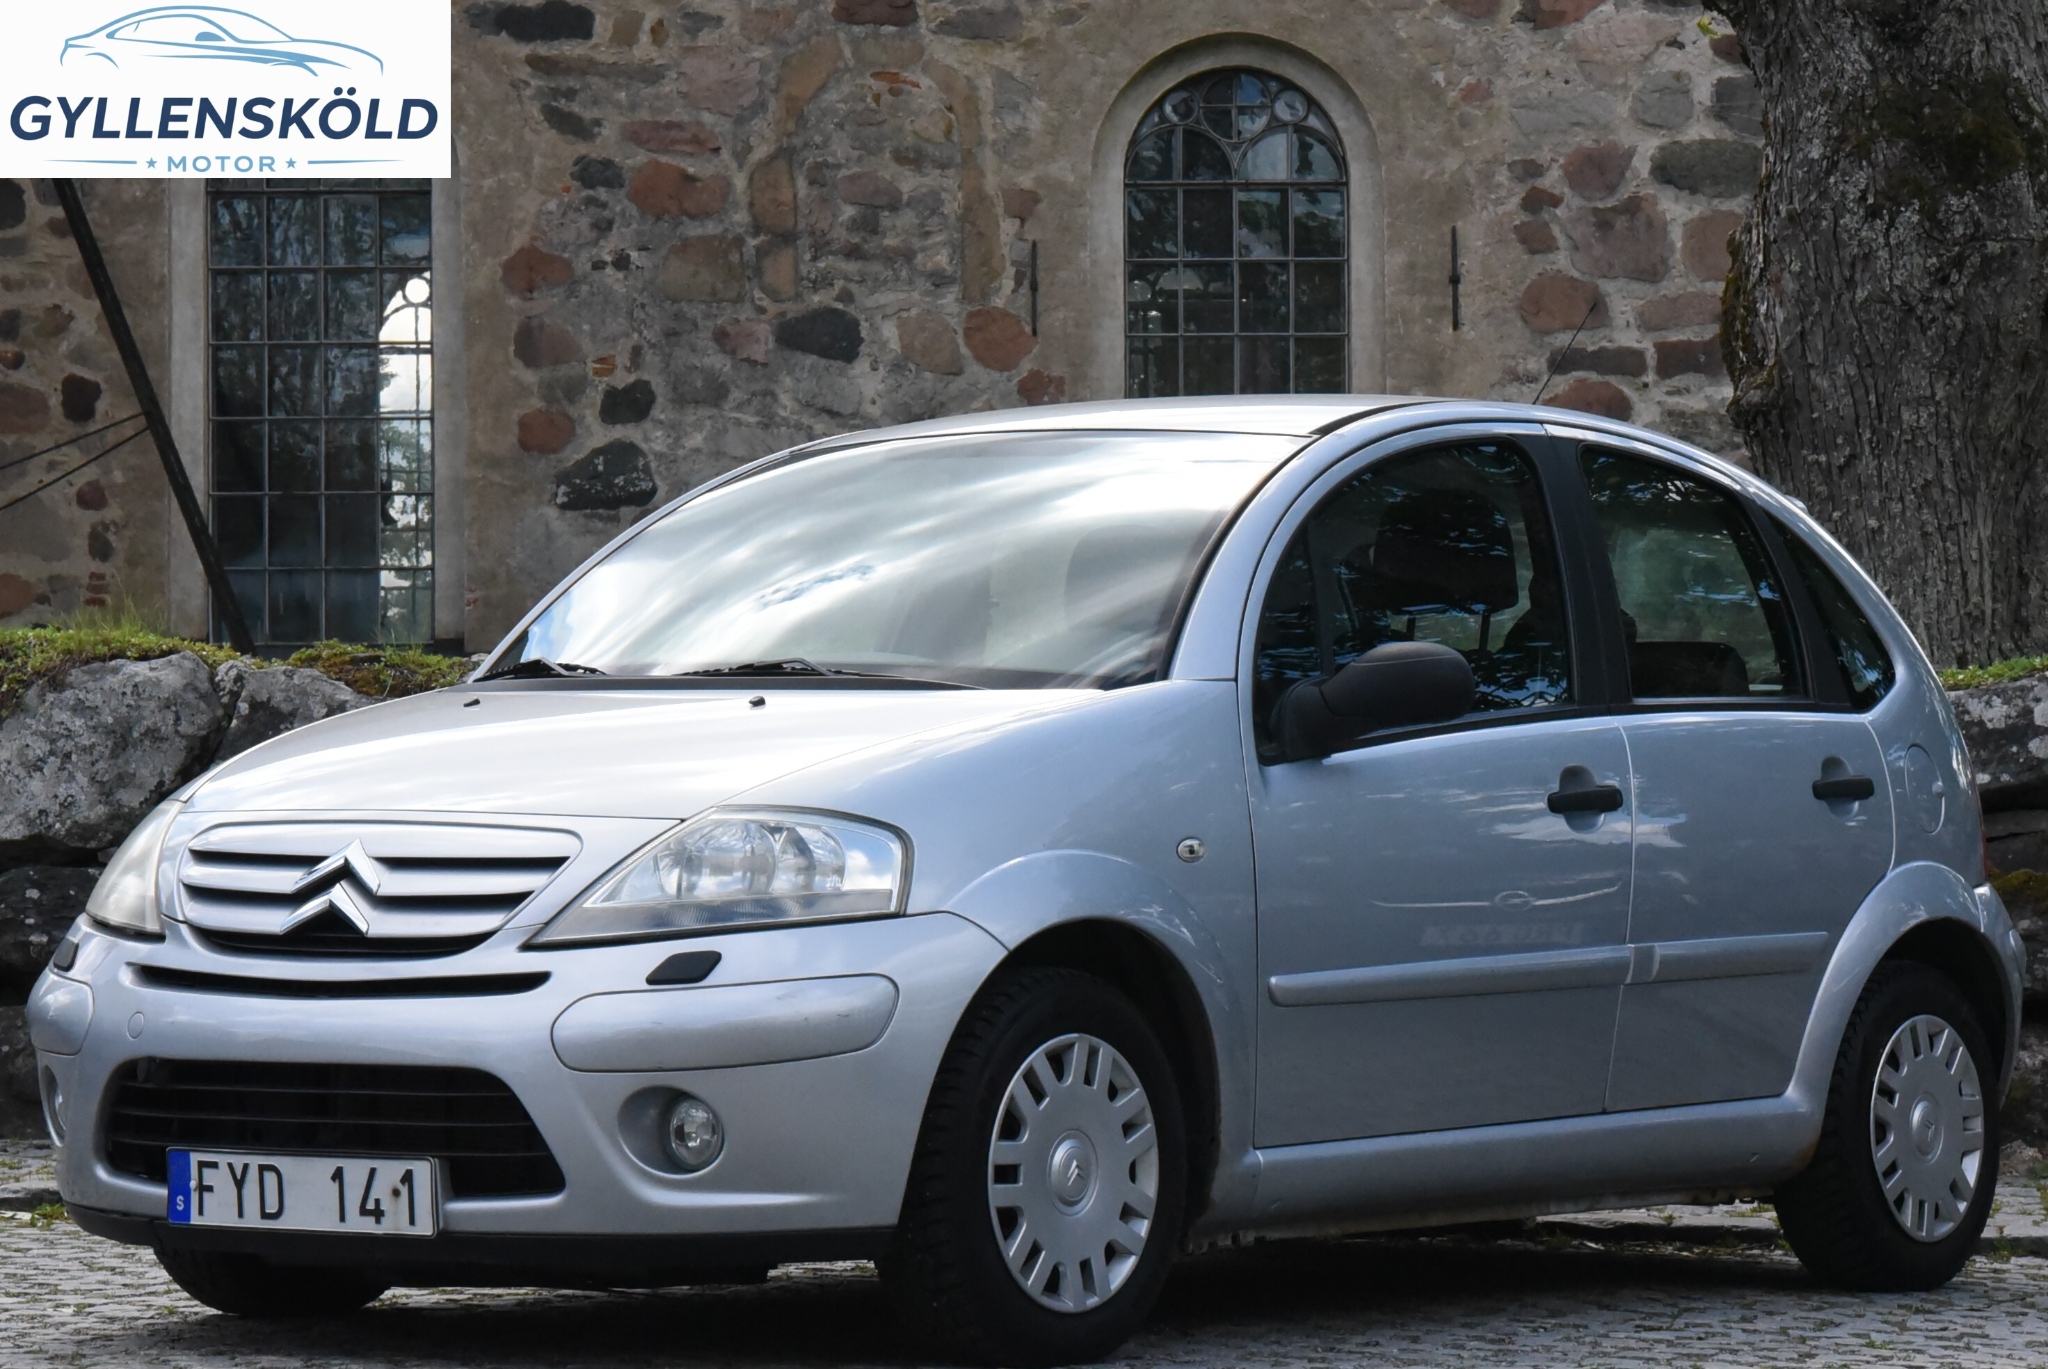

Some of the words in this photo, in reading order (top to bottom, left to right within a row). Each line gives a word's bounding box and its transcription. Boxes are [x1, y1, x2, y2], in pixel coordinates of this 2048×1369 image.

[176, 1195, 185, 1211] S
[196, 1159, 284, 1221] FYD
[330, 1165, 416, 1226] 141
